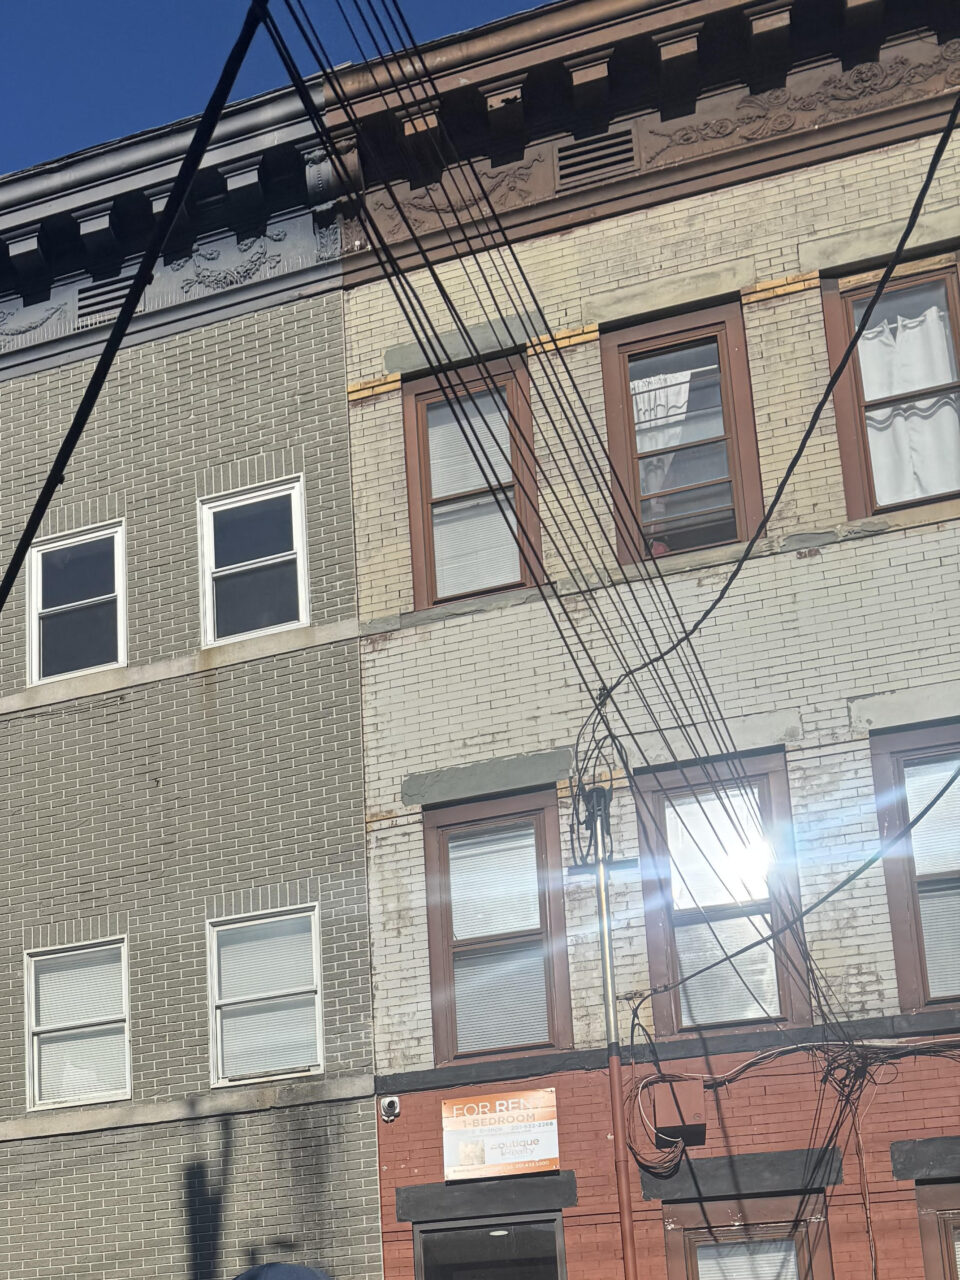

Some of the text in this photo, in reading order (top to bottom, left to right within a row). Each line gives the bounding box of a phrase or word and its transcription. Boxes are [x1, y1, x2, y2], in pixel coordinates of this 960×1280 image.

[453, 1099, 534, 1118] FOR REN
[463, 1114, 535, 1128] 1-BEDROOM
